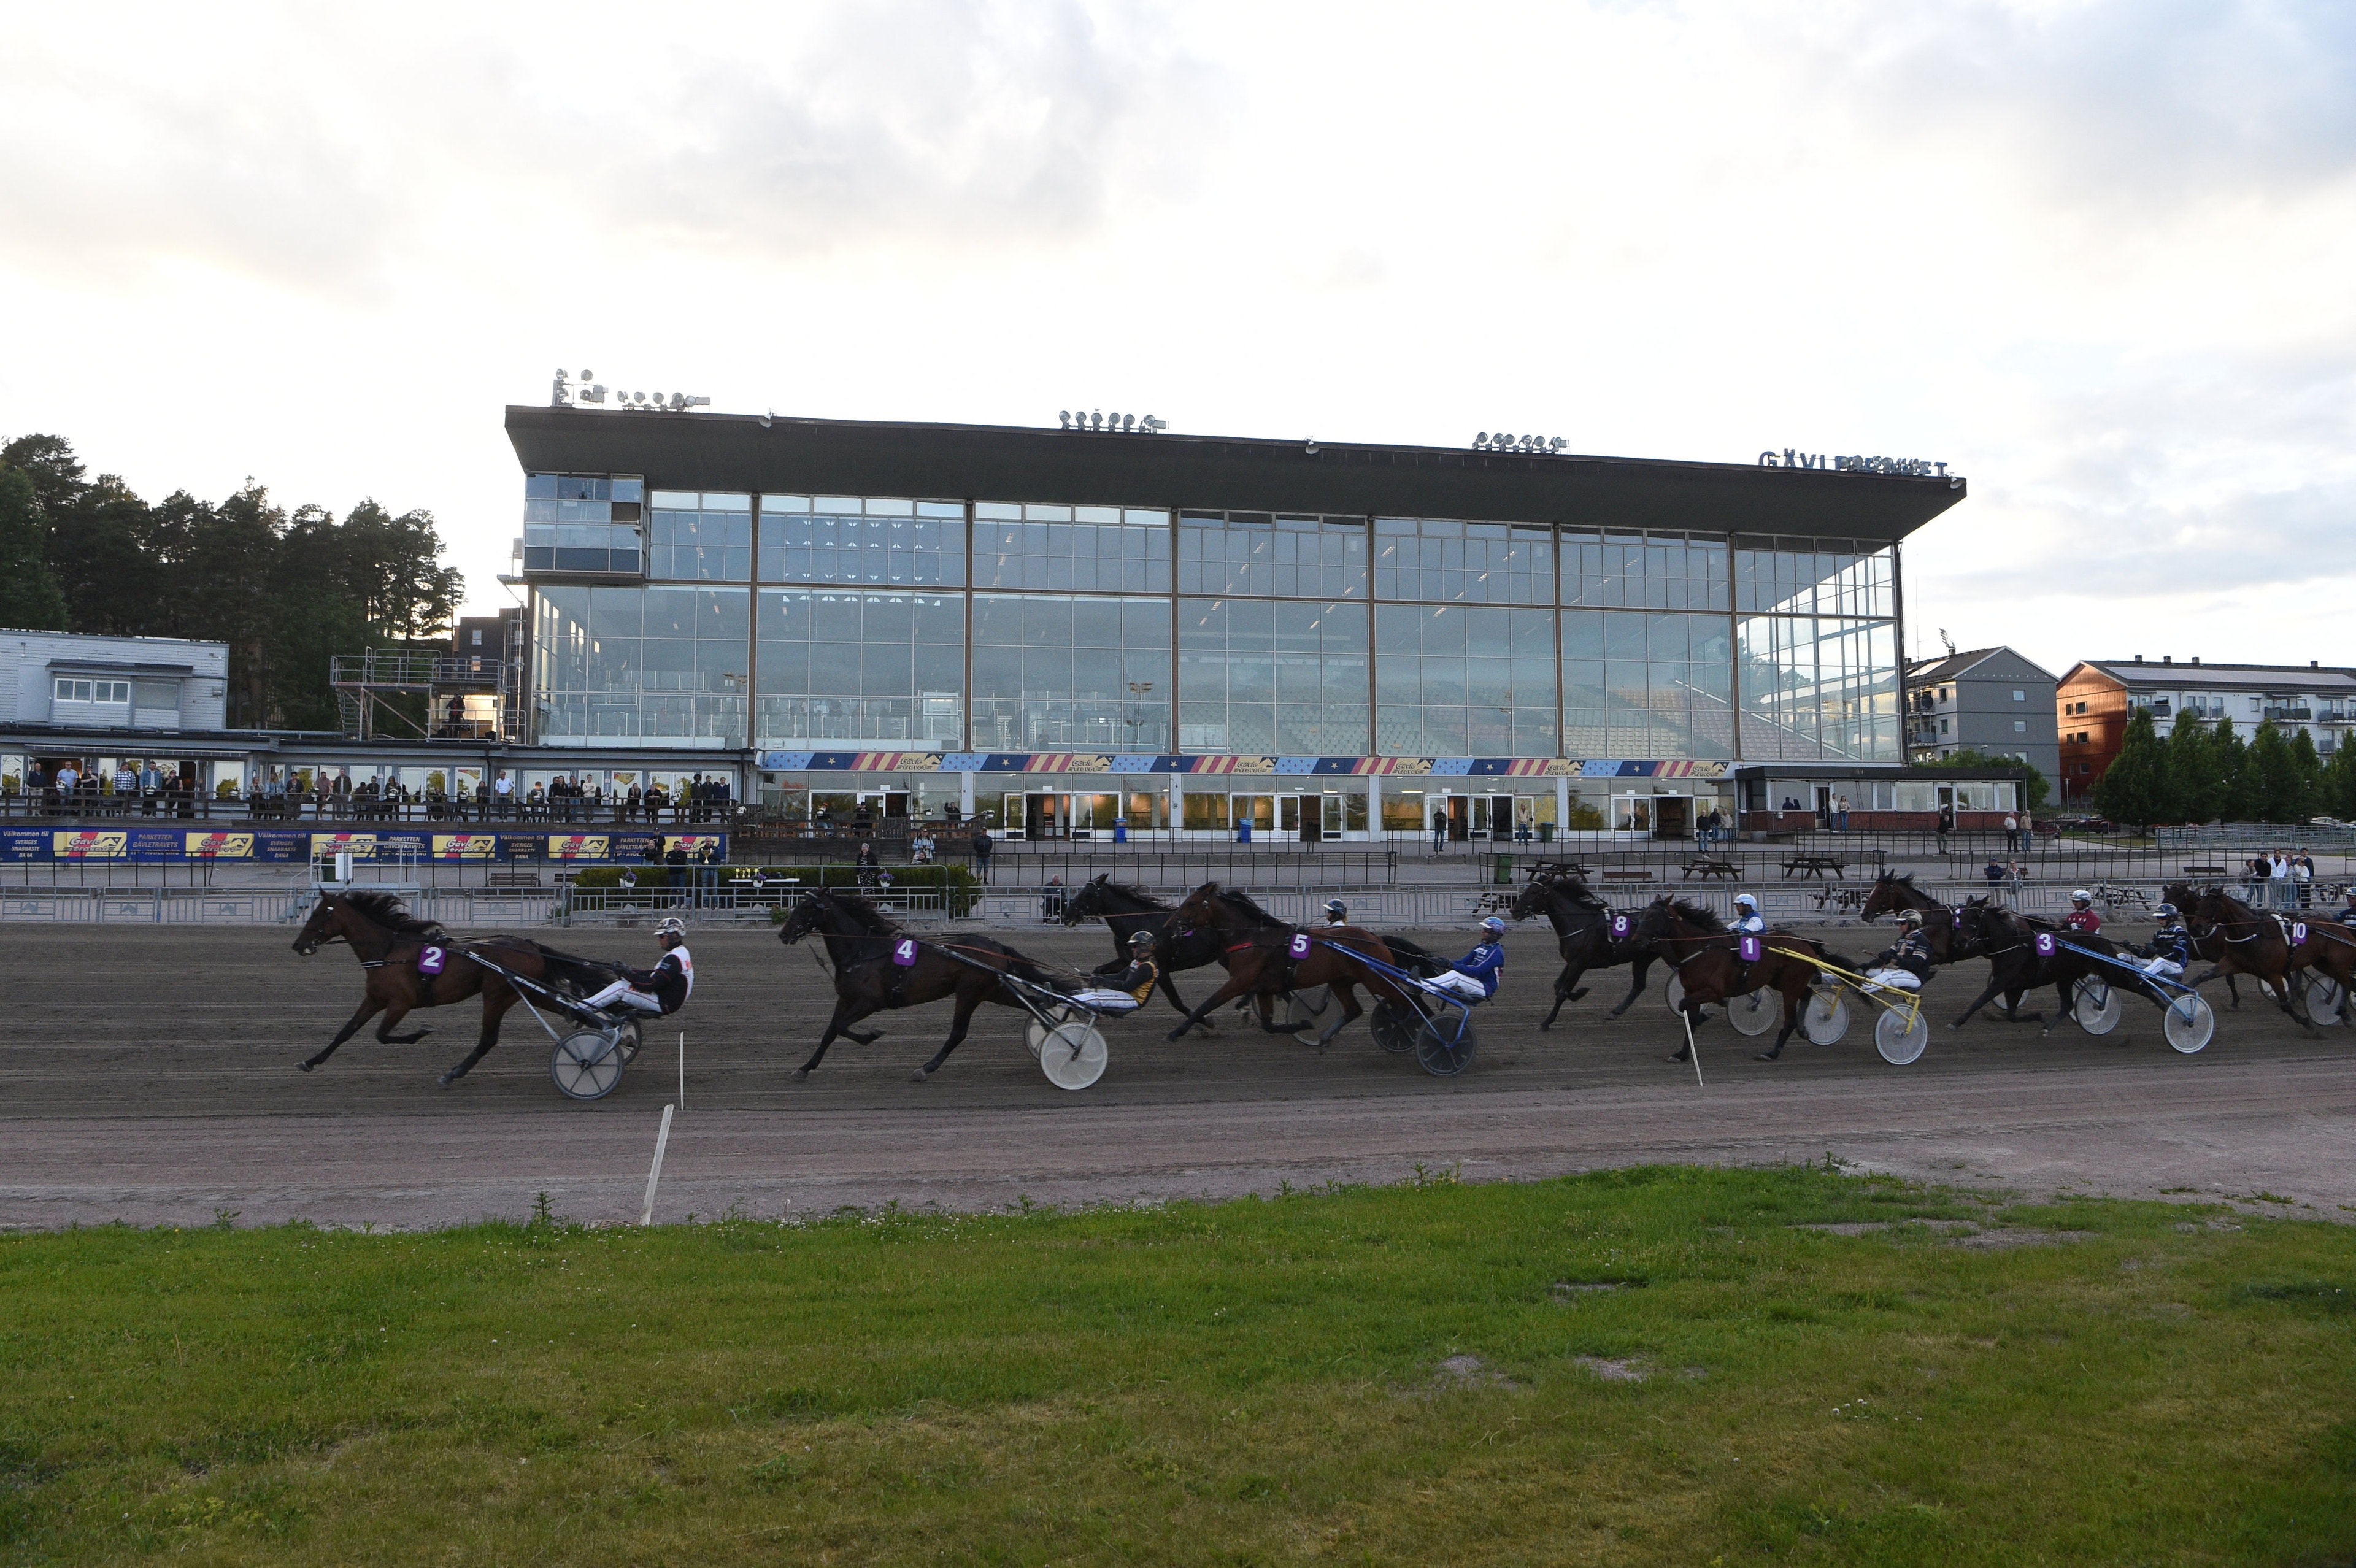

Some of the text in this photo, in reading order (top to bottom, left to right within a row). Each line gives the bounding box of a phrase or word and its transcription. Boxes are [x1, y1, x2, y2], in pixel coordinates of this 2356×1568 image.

[70, 836, 102, 846] Gävle
[202, 837, 230, 846] Gävle
[447, 839, 474, 848] Gävle
[562, 840, 590, 848] Gävle
[1615, 915, 1627, 931] 8
[2292, 922, 2306, 939] 10
[897, 940, 913, 959] 4
[1293, 934, 1308, 952] 5
[1745, 937, 1753, 954] 1
[2039, 933, 2052, 950] 3
[423, 947, 442, 967] 2
